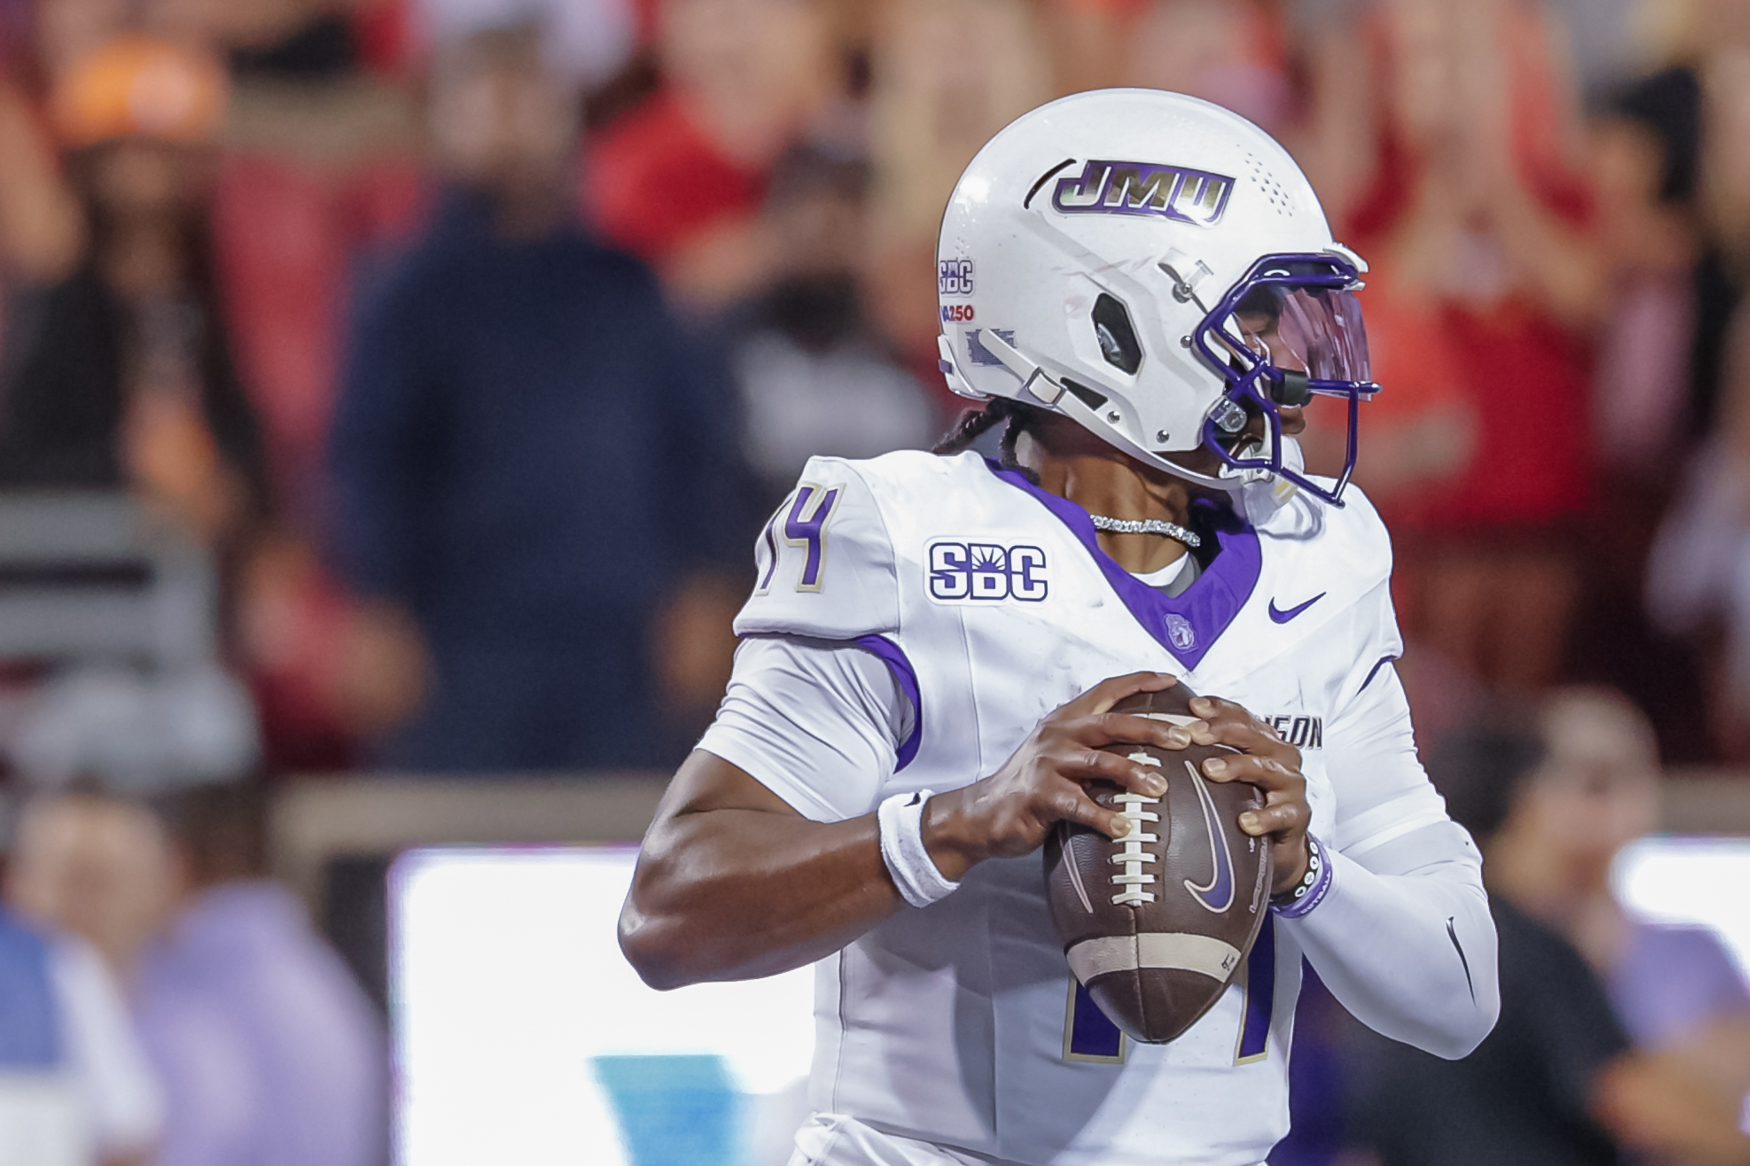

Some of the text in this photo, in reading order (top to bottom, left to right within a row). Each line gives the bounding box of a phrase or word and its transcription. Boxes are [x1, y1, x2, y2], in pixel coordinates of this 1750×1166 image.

[1053, 160, 1236, 226] JMU
[754, 482, 846, 594] 14
[929, 542, 1048, 602] SBC
[1263, 714, 1323, 751] SON
